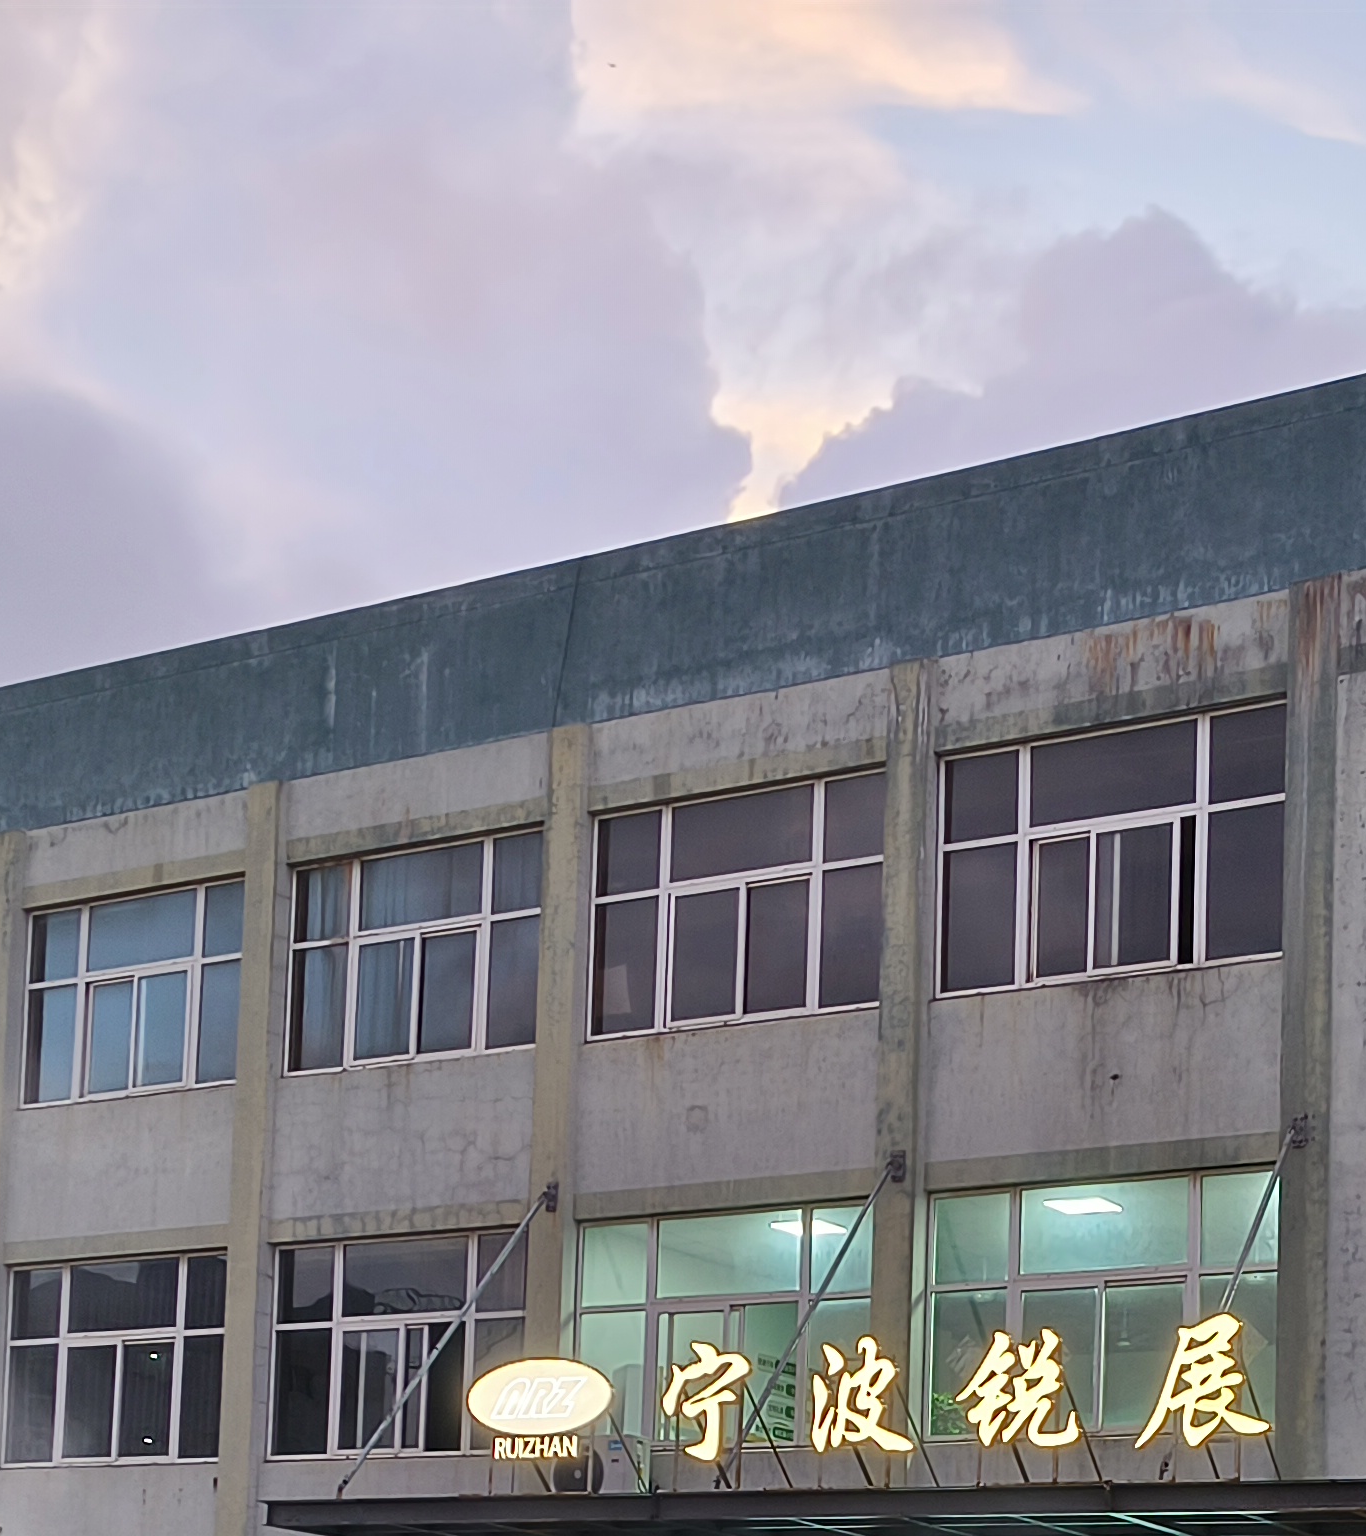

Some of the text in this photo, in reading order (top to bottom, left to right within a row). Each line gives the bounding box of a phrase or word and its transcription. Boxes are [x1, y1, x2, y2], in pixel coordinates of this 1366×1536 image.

[661, 1312, 1271, 1461] 宁波锐展
[493, 1434, 578, 1460] RUIZHAN
